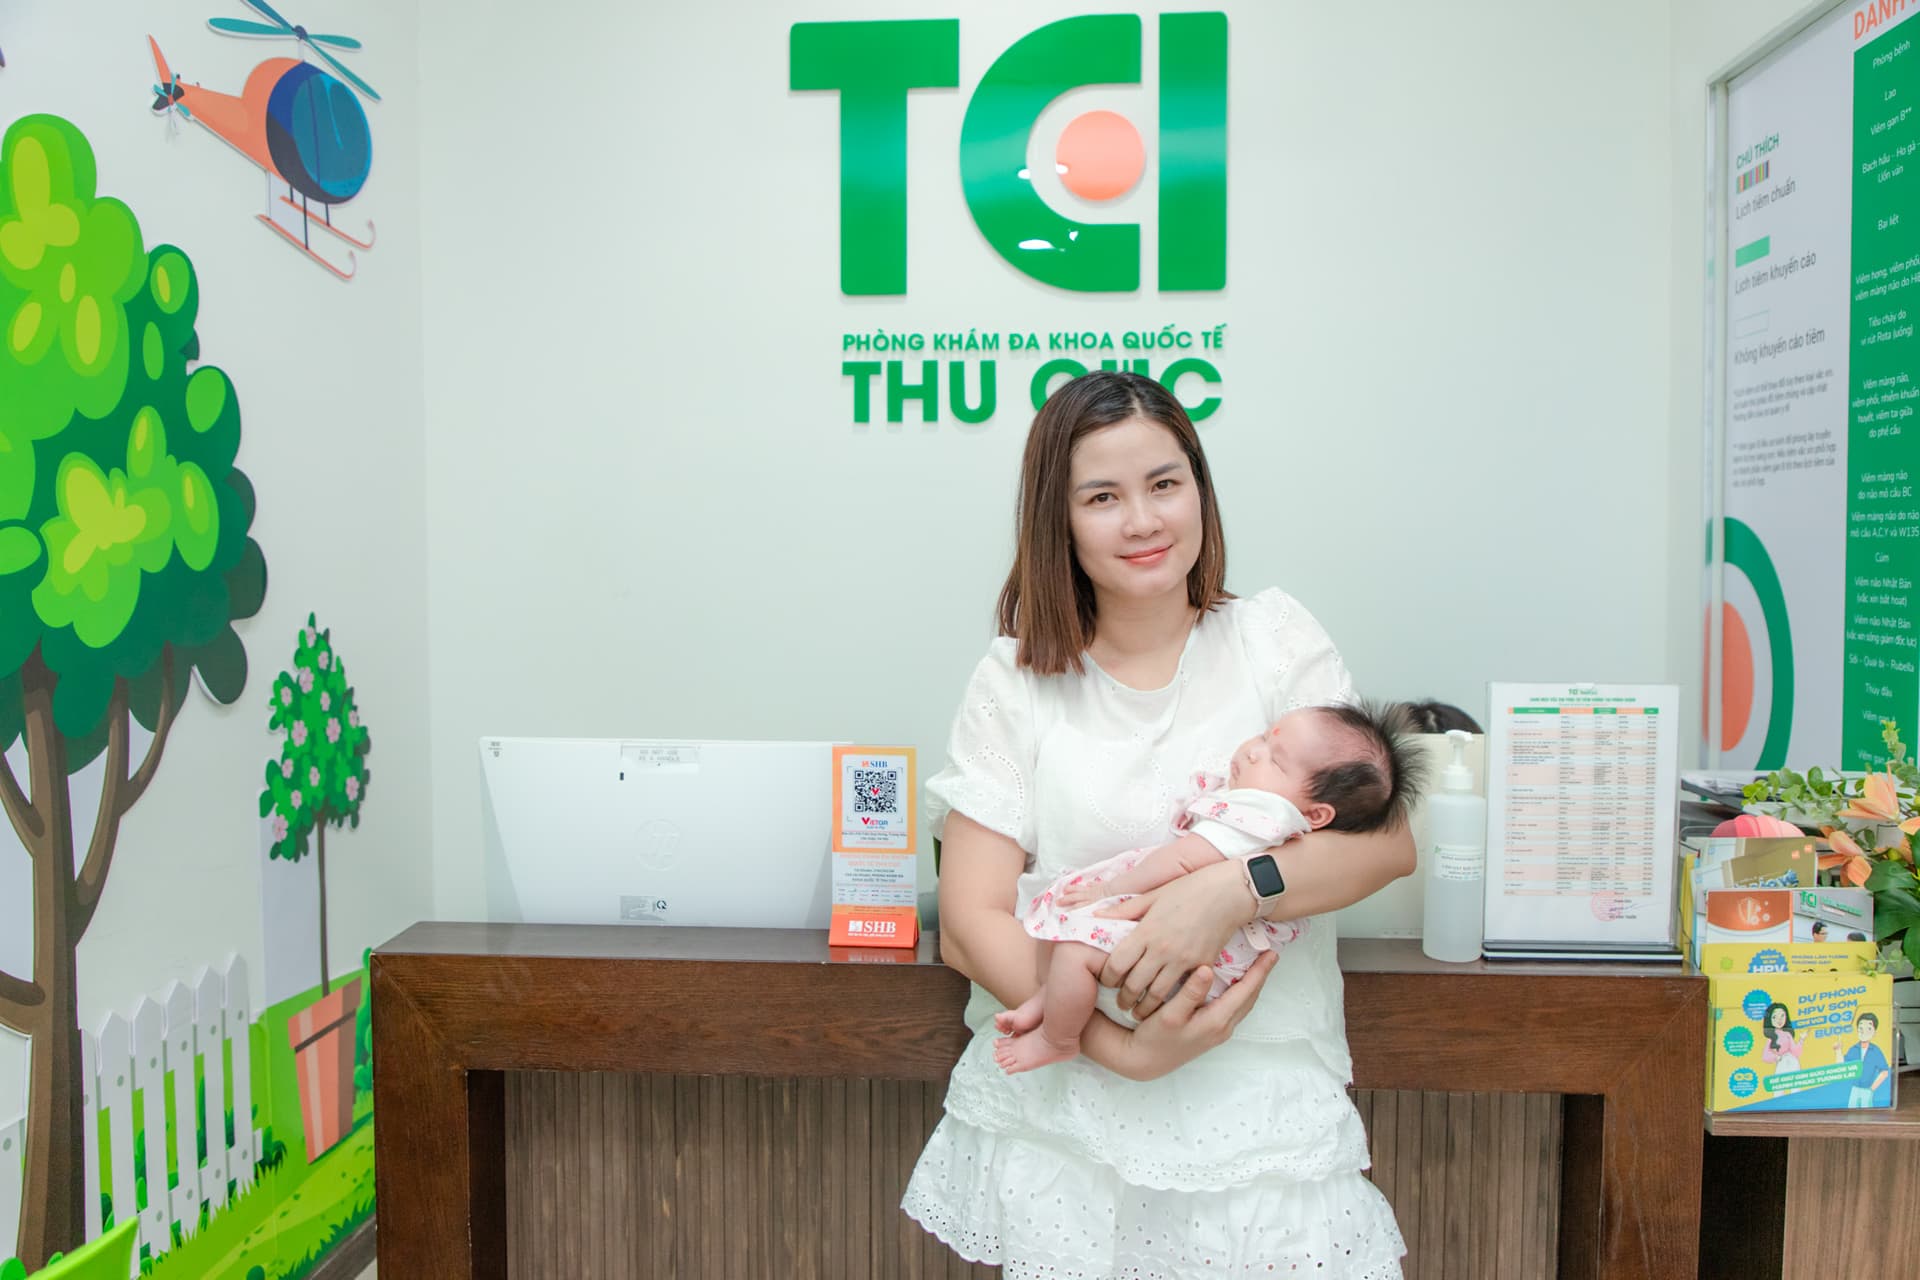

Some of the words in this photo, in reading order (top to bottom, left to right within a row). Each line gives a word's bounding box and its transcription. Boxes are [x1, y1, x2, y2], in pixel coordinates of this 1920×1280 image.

[1872, 51, 1893, 69] Phòng
[1893, 39, 1911, 57] bệnh
[1884, 88, 1897, 101] Lao
[1870, 122, 1886, 135] Viêm
[1886, 115, 1899, 130] gan
[789, 11, 1228, 296] TCI
[1754, 131, 1780, 160] THÍCH
[1896, 145, 1906, 157] Ho
[1907, 140, 1917, 155] gà
[1770, 176, 1796, 203] chuẩn
[1800, 250, 1817, 270] cáo
[1901, 276, 1910, 288] do
[1898, 308, 1907, 321] do
[842, 329, 925, 352] PHÒNG
[934, 328, 1000, 351] KHÁM
[1009, 332, 1040, 351] ĐA
[1049, 332, 1114, 350] KHOA
[1122, 324, 1193, 349] QUỐC
[1201, 323, 1228, 349] TẾ
[1788, 331, 1804, 351] cáo
[1805, 328, 1825, 346] tiêm
[842, 360, 997, 424] THU
[1030, 358, 1223, 422] CC
[1868, 427, 1877, 438] do
[1902, 486, 1912, 497] BC
[863, 921, 897, 934] SHB
[1797, 1004, 1826, 1017] HPV
[1828, 1010, 1854, 1024] 03
